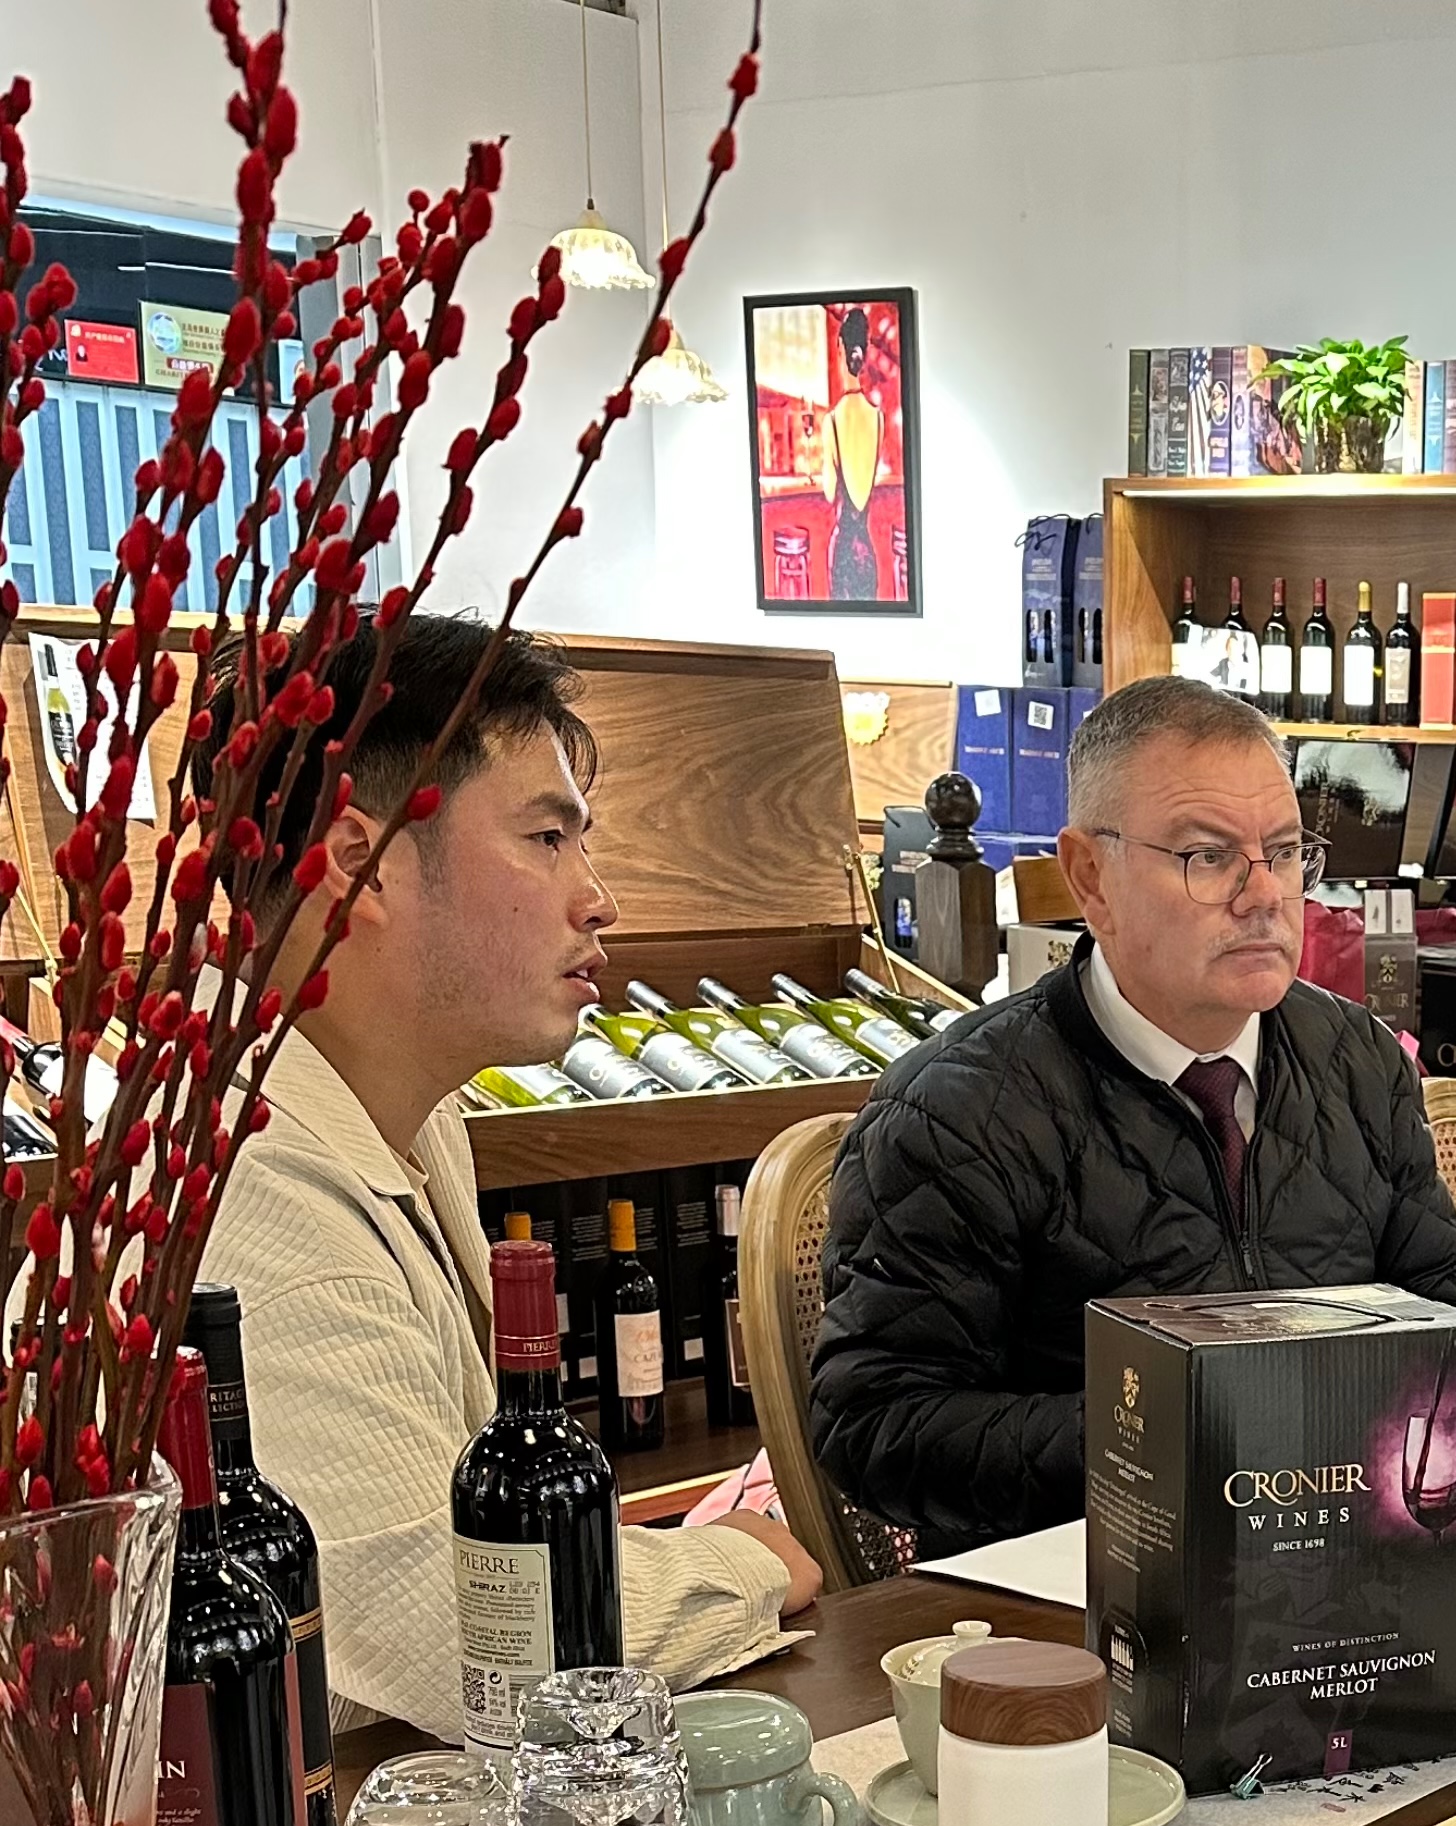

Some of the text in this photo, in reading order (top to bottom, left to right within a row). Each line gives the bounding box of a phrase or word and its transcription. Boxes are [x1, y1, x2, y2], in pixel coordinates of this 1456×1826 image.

[1223, 1463, 1372, 1508] CRONIER
[1248, 1507, 1350, 1531] WINES
[1273, 1538, 1325, 1552] SINCE 1698
[459, 1549, 520, 1574] PIERRE
[1292, 1632, 1399, 1652] WINES OF DISTINCTION
[1247, 1650, 1436, 1688] CABERNET SAUVIGNON
[1310, 1677, 1378, 1700] MERLOT
